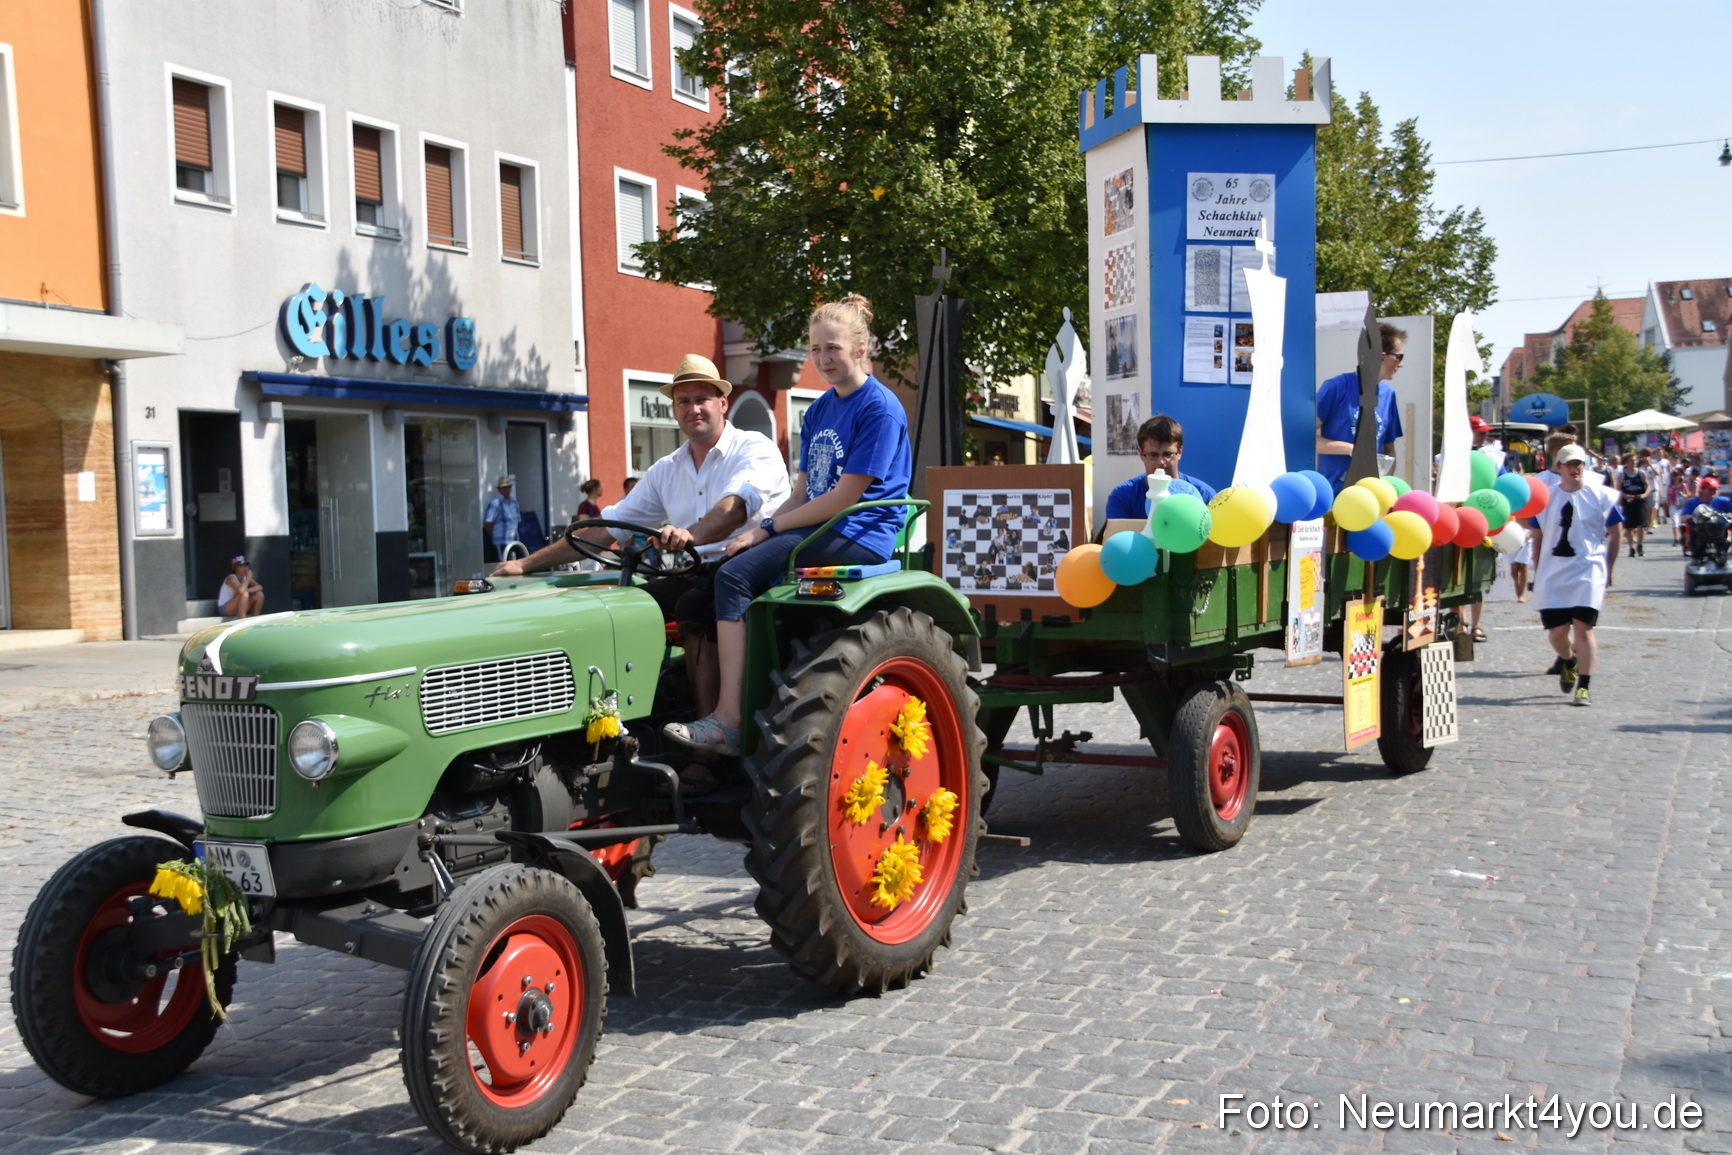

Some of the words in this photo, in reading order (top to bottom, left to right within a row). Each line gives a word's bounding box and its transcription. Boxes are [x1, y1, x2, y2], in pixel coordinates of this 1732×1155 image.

[1225, 177, 1239, 189] 65
[1215, 194, 1248, 205] Jahre
[1198, 210, 1264, 222] Schachklub
[1203, 226, 1259, 238] Neumarkt
[280, 282, 441, 367] Eilles
[145, 406, 156, 419] 31
[179, 675, 256, 700] FENDT
